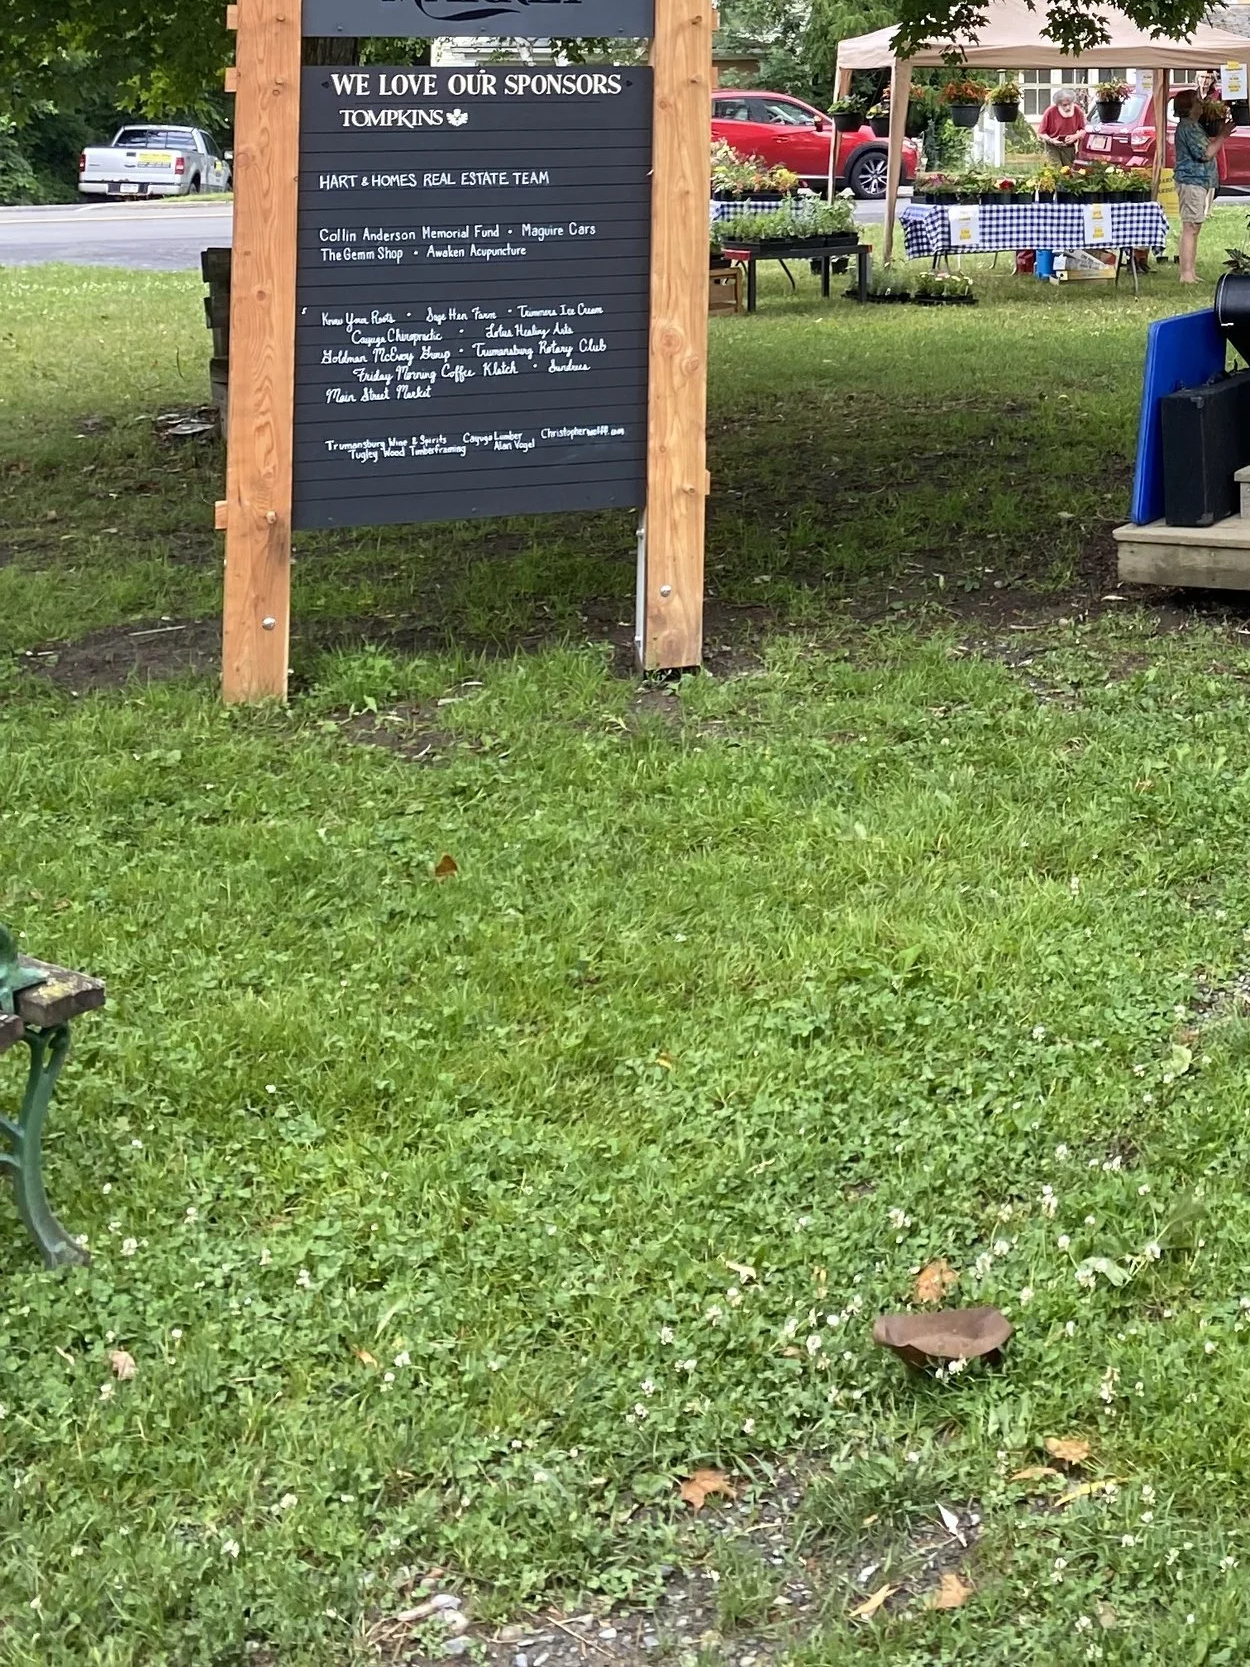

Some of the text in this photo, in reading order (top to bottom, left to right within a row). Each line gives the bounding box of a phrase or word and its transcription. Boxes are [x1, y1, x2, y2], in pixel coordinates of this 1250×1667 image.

[330, 72, 622, 96] WE LOVE OUR SPONSORS
[339, 109, 444, 129] TOMPKINS
[319, 171, 550, 190] HART & HOMES REAL ESTATE TEAM
[319, 222, 596, 242] Collin Anderson Memorial Fund Maguire Cars
[377, 247, 404, 264] Shop
[426, 245, 465, 258] Awaken
[469, 243, 527, 261] Acupuncture
[345, 313, 370, 333] Your
[370, 310, 397, 325] Roots
[426, 307, 447, 325] Sage
[448, 307, 469, 321] Hen
[471, 307, 498, 320] Farm
[559, 304, 576, 316] Ice
[577, 302, 604, 316] Cream
[351, 329, 386, 347] Cayuga
[387, 327, 443, 346] Chiropractic
[514, 324, 550, 339] Healing
[552, 322, 574, 335] Arts
[320, 350, 369, 364] Goldman
[420, 346, 451, 362] Group
[471, 343, 534, 360] Trumansburg
[538, 340, 574, 357] Rotary
[578, 338, 607, 352] Club
[352, 368, 394, 385] Friday
[395, 365, 437, 383] Morning
[441, 363, 476, 383] Coffee
[482, 361, 519, 376] Klatch
[325, 385, 432, 403] Main Street Market
[324, 438, 385, 451] Trumansburg
[387, 437, 408, 447] Wine
[420, 434, 447, 446] Spirits
[462, 432, 493, 446] Cayuga
[494, 431, 523, 441] Lumber
[348, 438, 535, 463] Tugley Wood Timberframing Alan Vogel
